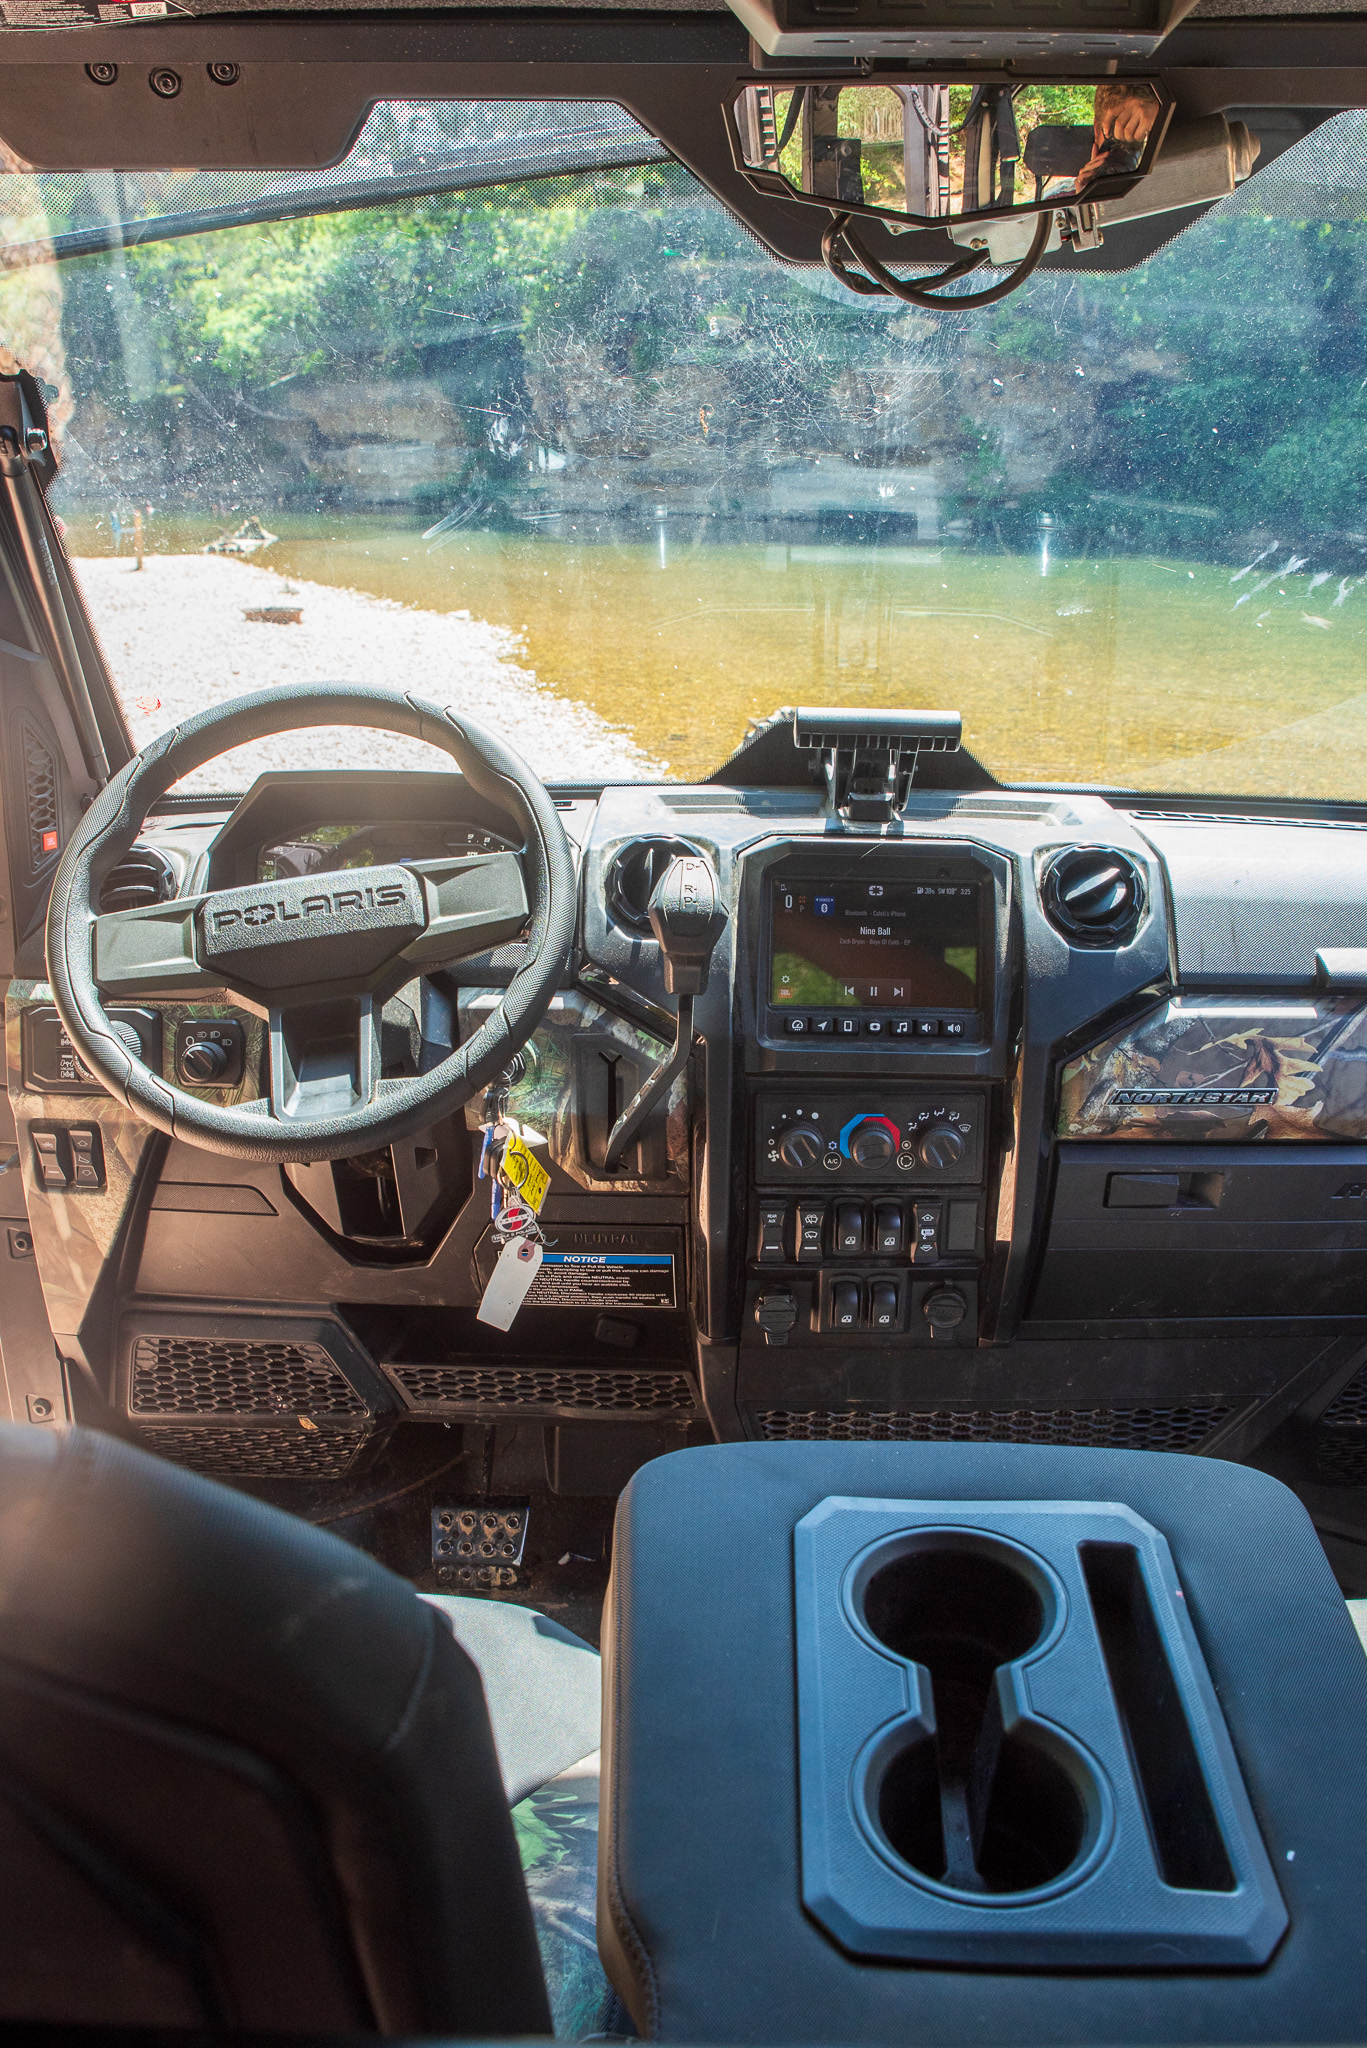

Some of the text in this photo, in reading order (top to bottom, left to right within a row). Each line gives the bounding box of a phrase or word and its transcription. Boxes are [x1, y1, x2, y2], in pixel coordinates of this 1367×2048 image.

[785, 895, 793, 909] 0
[212, 884, 406, 934] POLARIS
[860, 927, 891, 936] Nine Ball
[1114, 1091, 1270, 1104] NORTHSTAR
[574, 1233, 639, 1245] NEUTRAL
